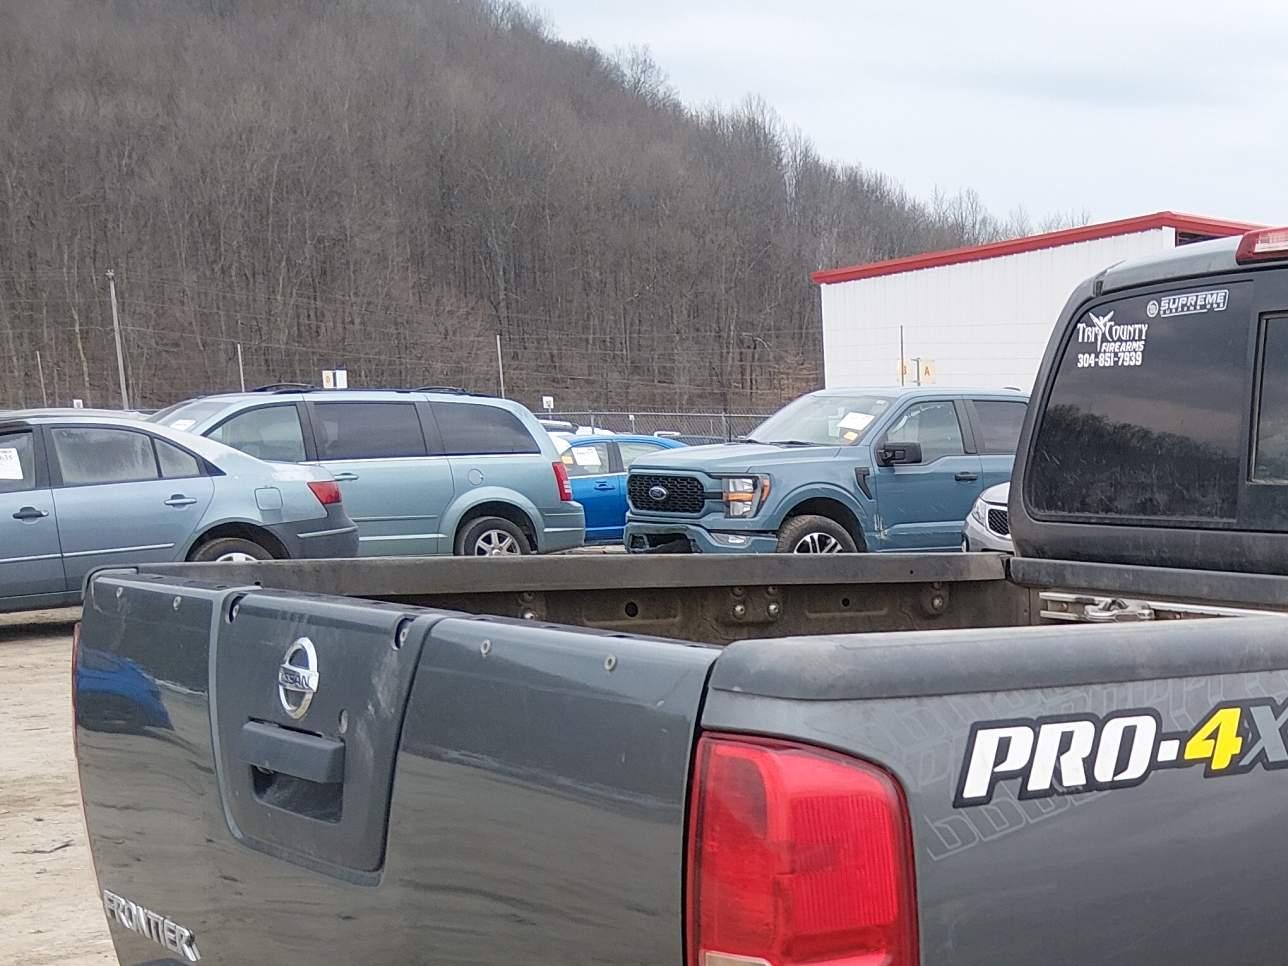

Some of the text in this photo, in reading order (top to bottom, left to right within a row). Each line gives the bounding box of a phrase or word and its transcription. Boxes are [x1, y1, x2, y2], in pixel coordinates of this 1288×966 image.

[1160, 292, 1226, 311] SUPREME
[1101, 340, 1146, 353] FIREARMS
[1077, 352, 1143, 369] 304-851-7939
[103, 889, 201, 962] FRONTIER
